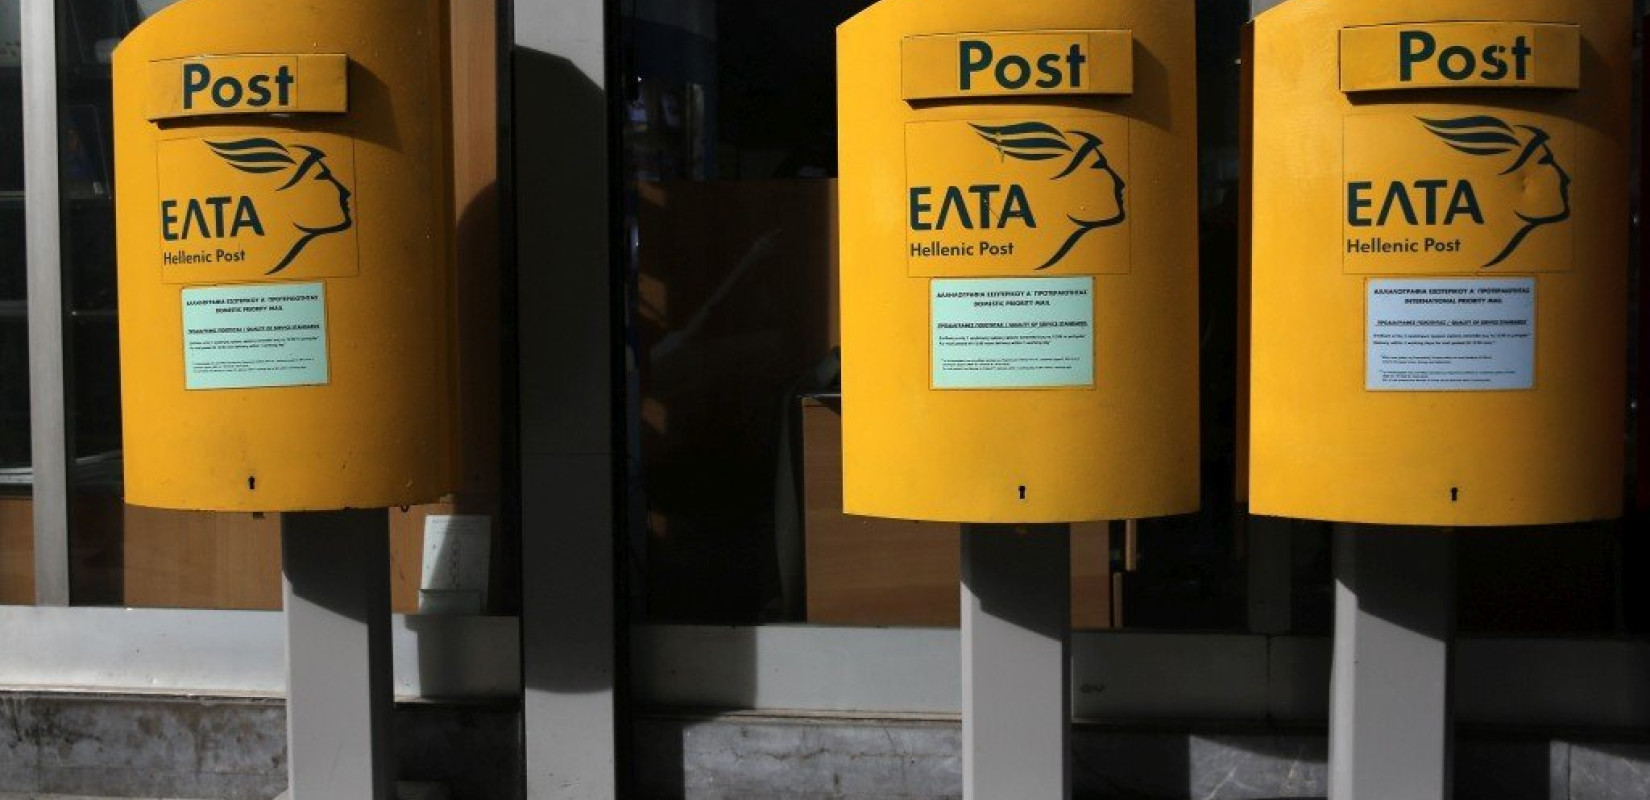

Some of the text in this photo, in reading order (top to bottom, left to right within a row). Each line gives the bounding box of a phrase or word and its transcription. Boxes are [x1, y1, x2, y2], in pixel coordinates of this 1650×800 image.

[958, 40, 1087, 91] Post
[1399, 30, 1532, 82] Post
[183, 63, 294, 110] Post
[161, 195, 265, 242] ΕΛΤΑ
[909, 184, 1037, 231] ΕΛΤΑ
[1348, 179, 1485, 227] ΕΛΤΑ
[163, 249, 246, 265] Hellenic Post
[910, 241, 1014, 258] Hellenic Post
[1346, 237, 1462, 254] Hellenic Post
